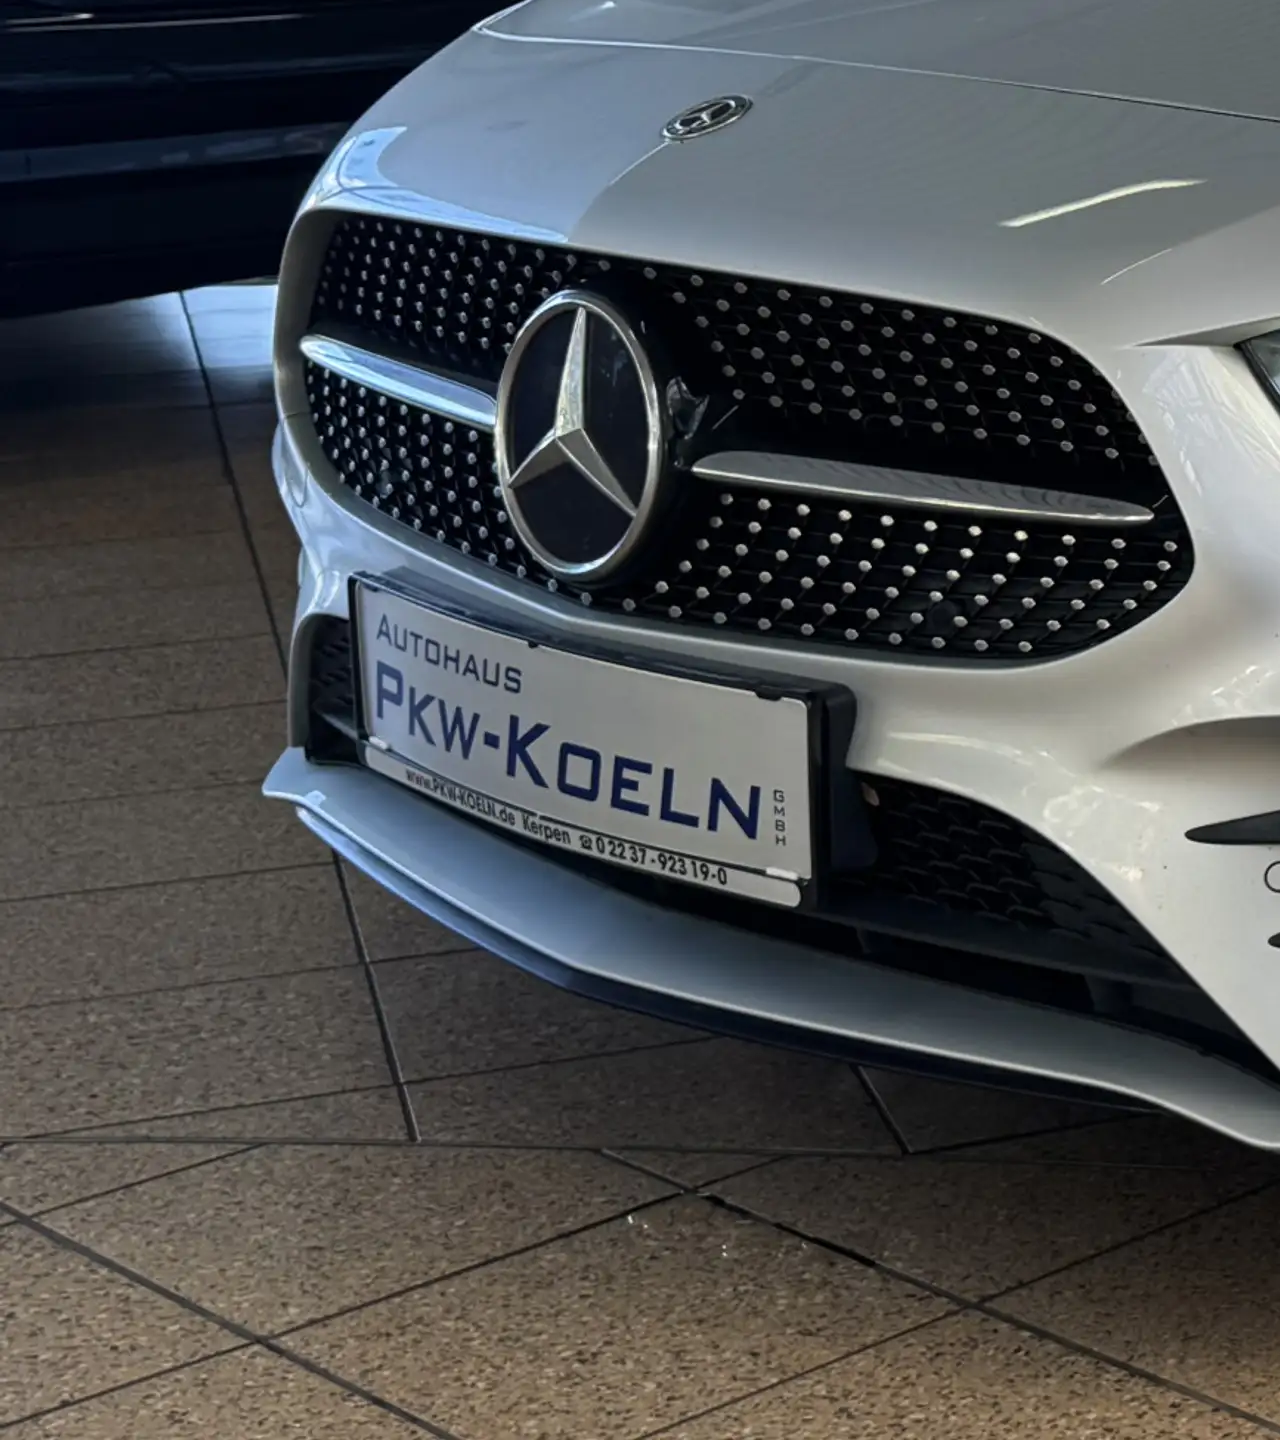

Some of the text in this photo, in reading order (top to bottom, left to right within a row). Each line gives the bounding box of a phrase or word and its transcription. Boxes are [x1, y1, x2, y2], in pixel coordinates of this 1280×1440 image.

[376, 613, 522, 694] AUTOHAUS
[376, 660, 761, 841] PKW-KOELN
[405, 769, 516, 827] www.PKW-KOELN.de
[522, 813, 572, 845] Kerpen
